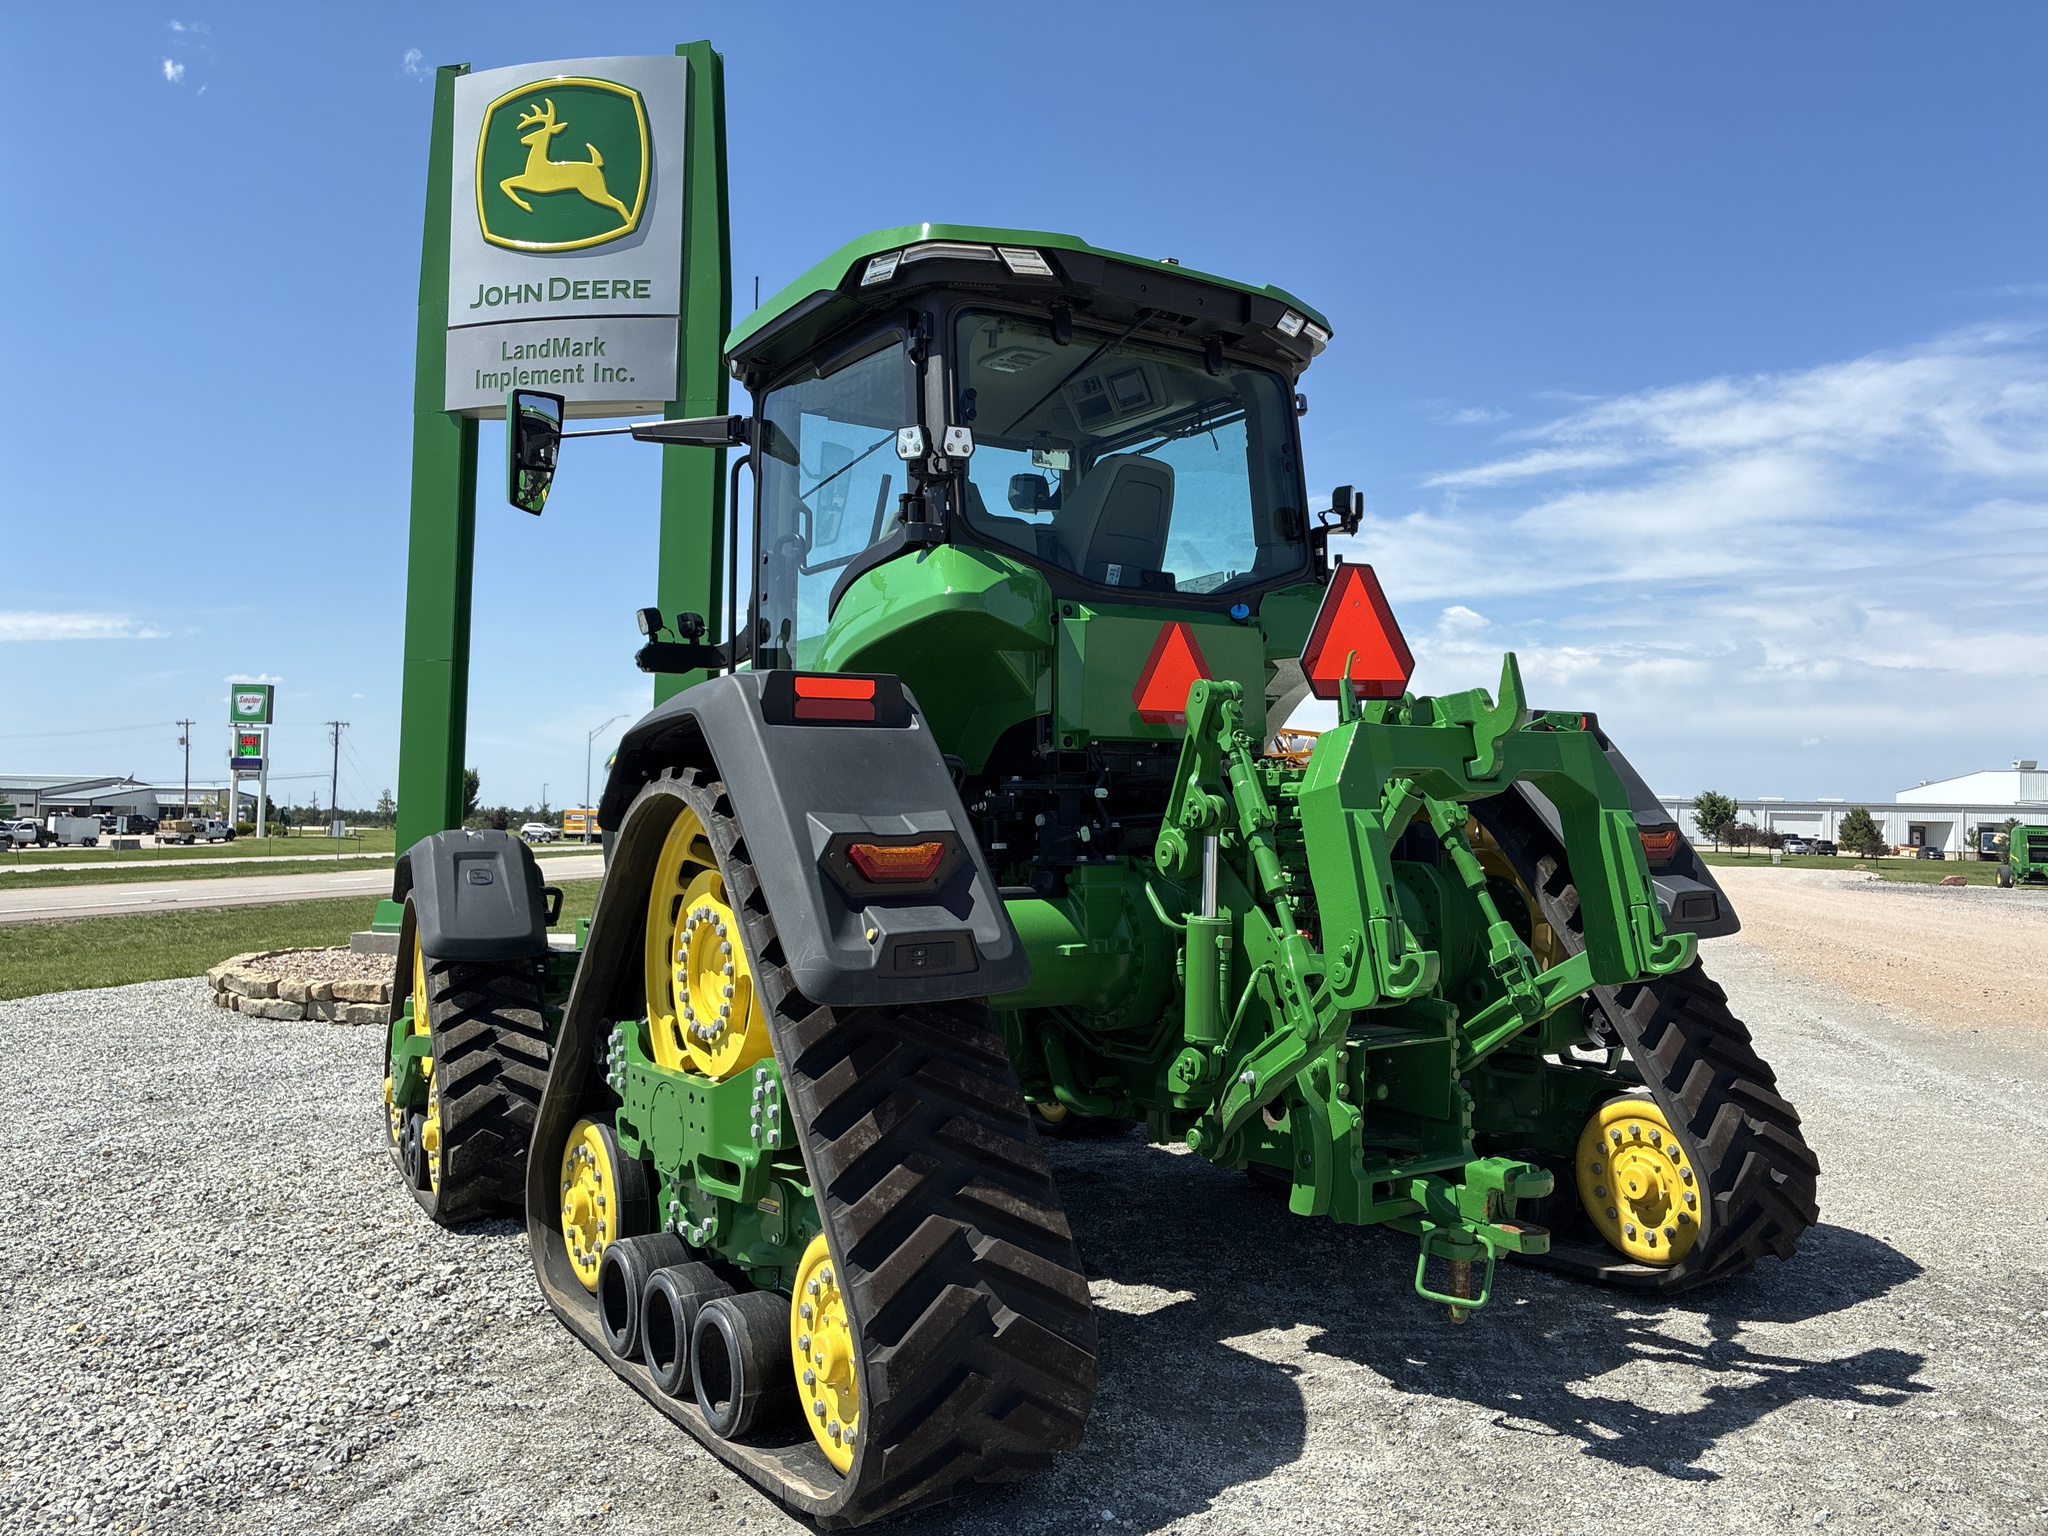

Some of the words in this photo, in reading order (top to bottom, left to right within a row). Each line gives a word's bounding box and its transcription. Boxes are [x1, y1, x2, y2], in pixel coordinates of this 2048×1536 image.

[470, 283, 542, 309] JOHN
[549, 277, 651, 302] DEERE
[502, 337, 606, 361] LandMark
[476, 364, 585, 392] Implement
[594, 363, 635, 383] Inc.
